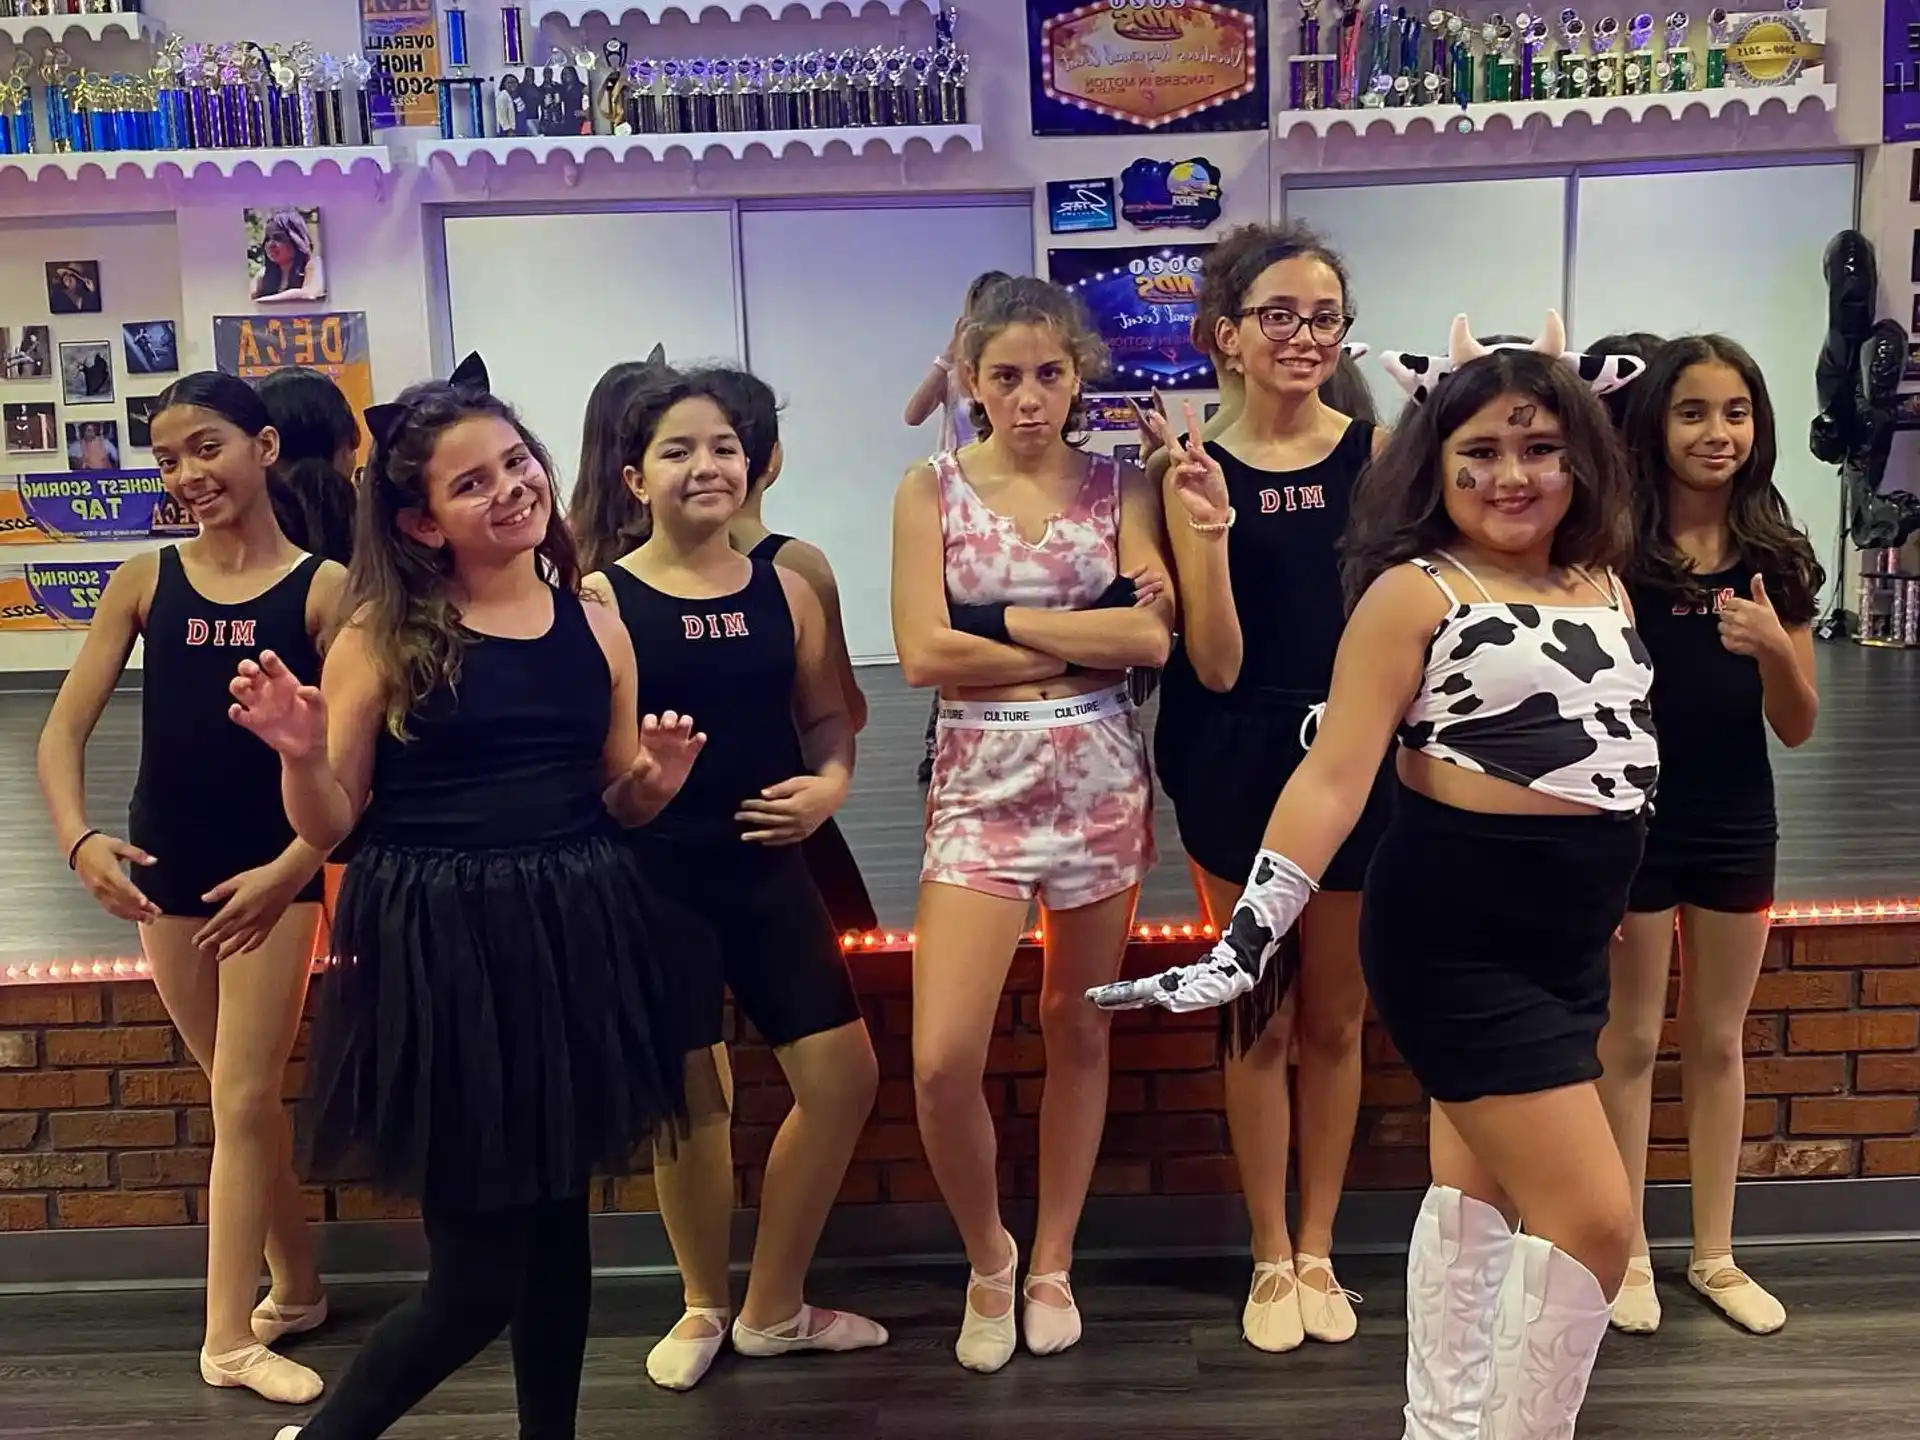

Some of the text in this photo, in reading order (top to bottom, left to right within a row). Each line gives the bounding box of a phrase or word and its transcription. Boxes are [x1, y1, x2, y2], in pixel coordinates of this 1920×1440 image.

[1259, 485, 1325, 513] DIM
[186, 618, 256, 646] DIM
[681, 612, 749, 639] DIM
[983, 711, 1030, 722] CULTURE
[1054, 700, 1100, 719] CULTURE
